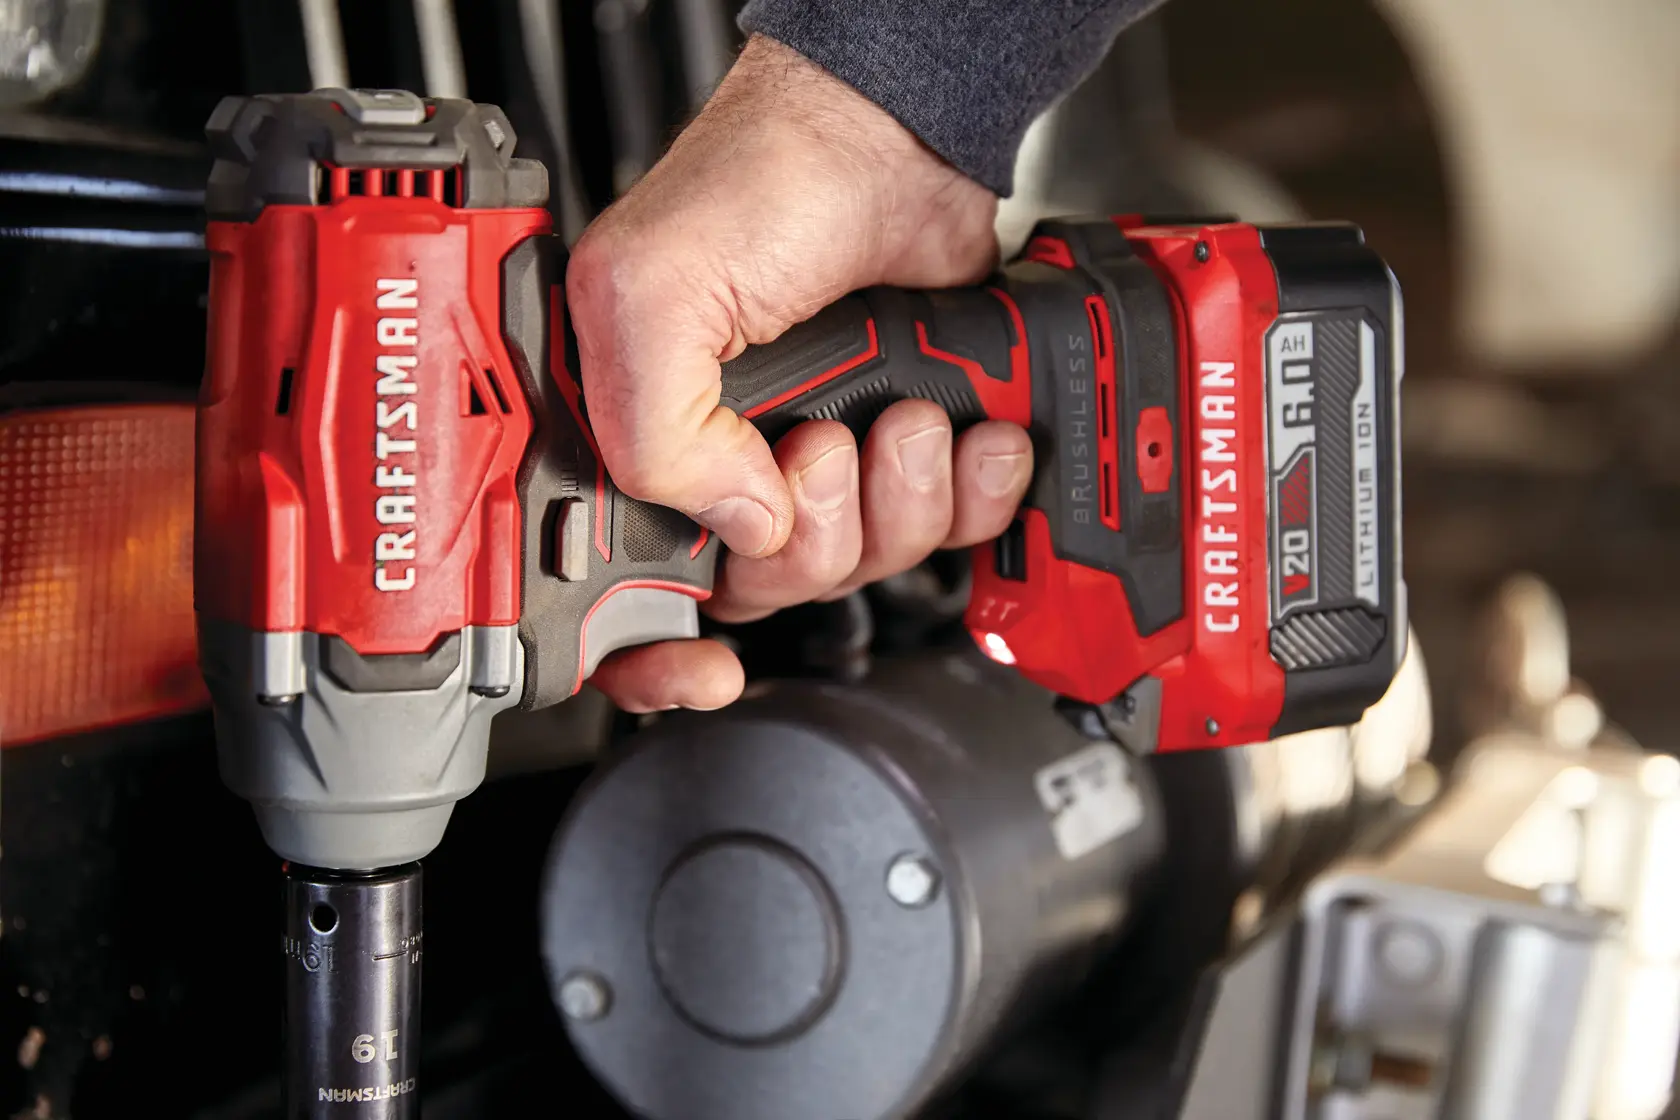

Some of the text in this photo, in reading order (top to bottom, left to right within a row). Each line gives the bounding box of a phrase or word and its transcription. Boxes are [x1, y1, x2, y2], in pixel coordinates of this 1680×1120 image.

[1281, 335, 1306, 352] AH
[1281, 358, 1316, 429] 6.0
[375, 278, 418, 592] CRAFTSMAN
[1069, 334, 1092, 525] BRUSHLESS
[1200, 361, 1240, 633] CRAFTSMAN
[1357, 402, 1374, 587] LITHIUM ION
[1282, 529, 1310, 597] V20
[352, 1029, 399, 1063] 19
[318, 1077, 416, 1102] CRAFTSMAN
